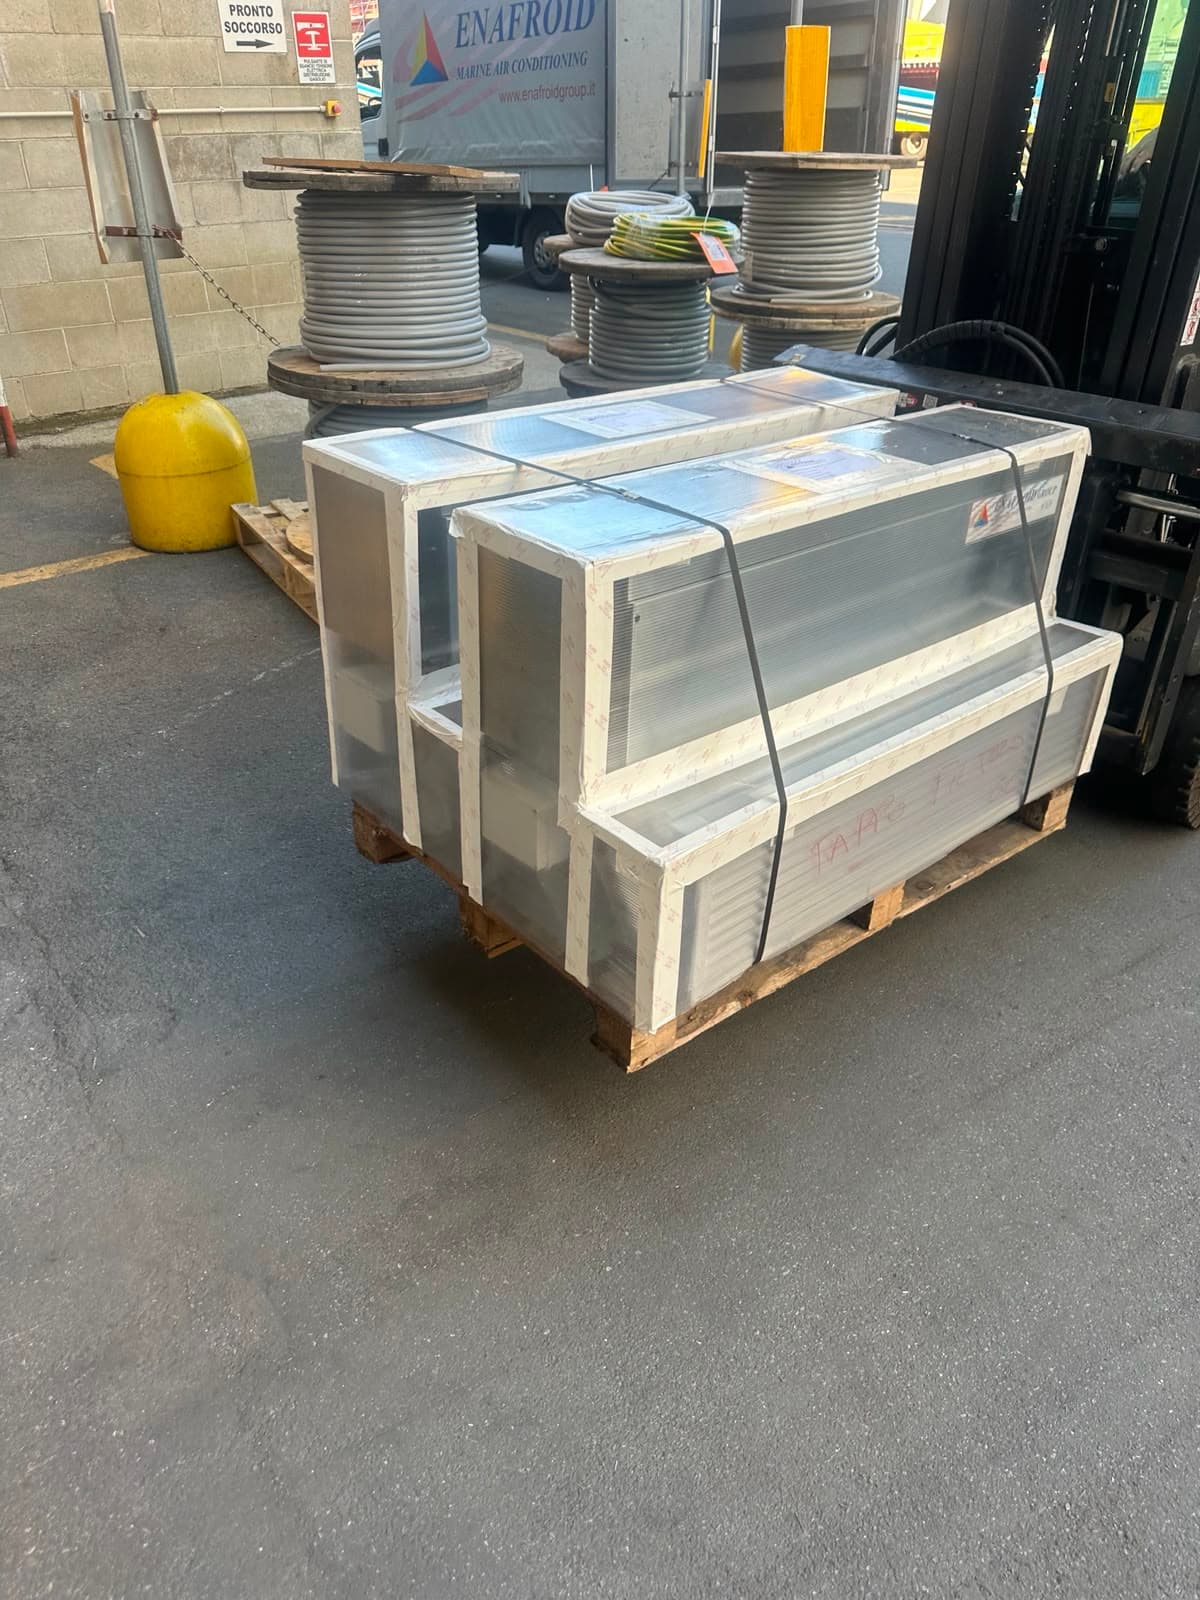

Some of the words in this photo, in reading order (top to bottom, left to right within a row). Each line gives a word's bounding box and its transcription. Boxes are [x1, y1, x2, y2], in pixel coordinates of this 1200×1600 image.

[229, 4, 273, 17] PRONTO
[224, 21, 282, 34] SOCCORSO
[455, 0, 595, 48] ENAFROID
[456, 63, 491, 80] MARINE
[495, 61, 510, 75] AIR
[512, 51, 588, 74] CONDITIONING
[499, 82, 595, 103] www.enafroidgroup.it
